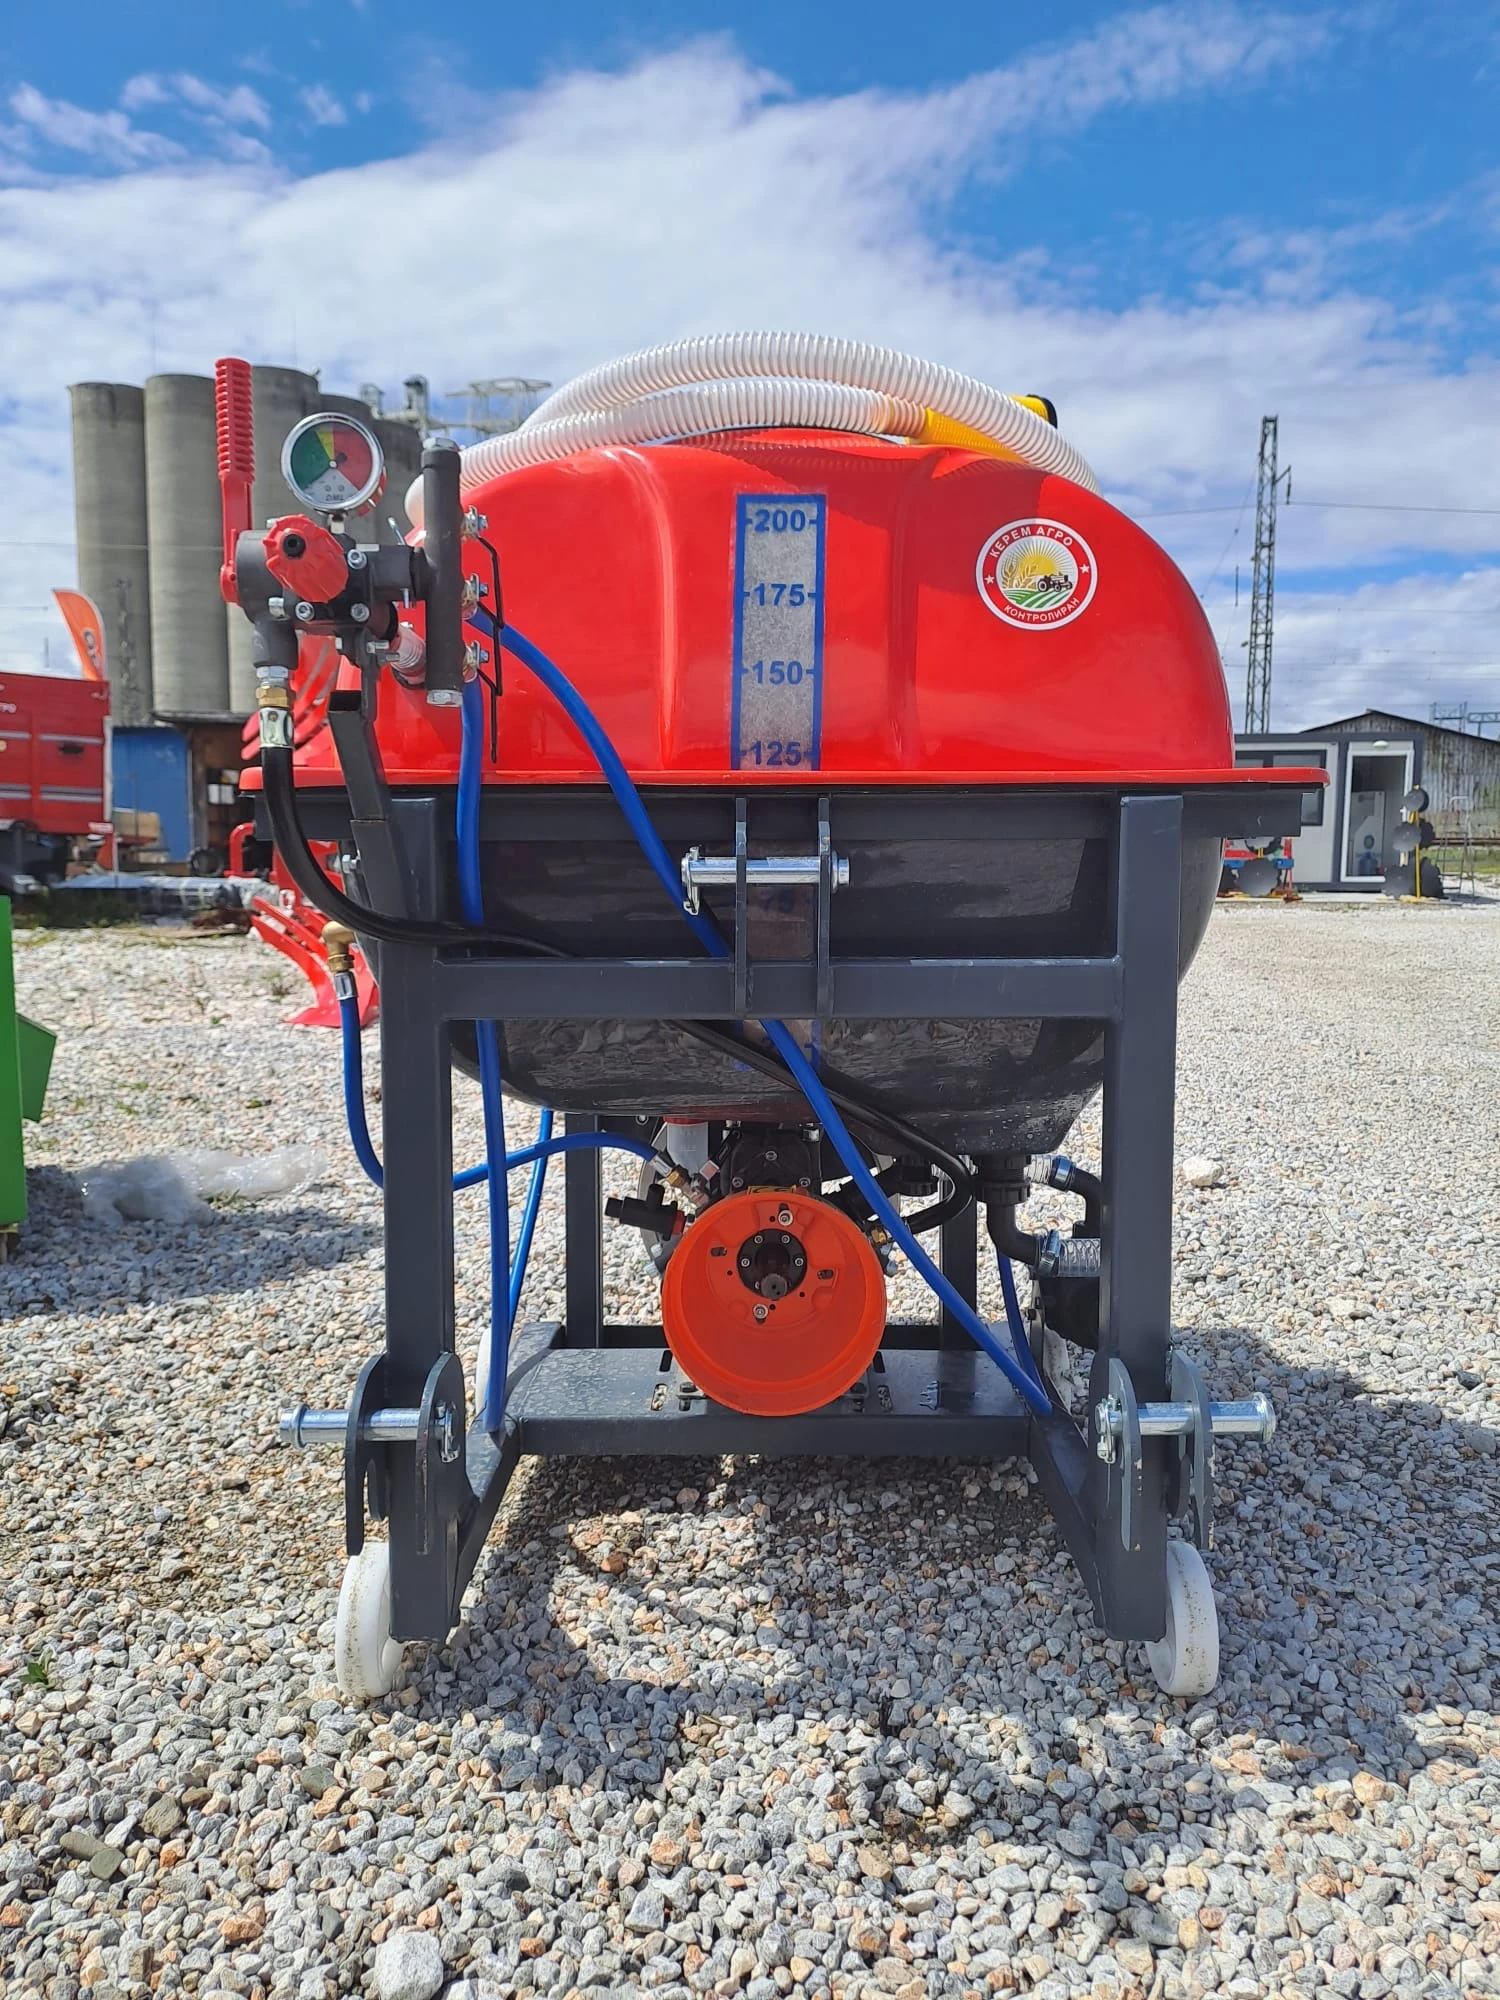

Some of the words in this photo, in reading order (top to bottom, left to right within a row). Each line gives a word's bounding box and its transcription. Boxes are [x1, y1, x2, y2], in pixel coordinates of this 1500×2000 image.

[754, 509, 806, 533] 200
[990, 527, 1031, 558] КЕРЕМ
[1036, 526, 1073, 546] АГРО
[754, 583, 805, 607] 175
[1004, 598, 1080, 622] КОНТРОЛИРАН
[752, 661, 803, 685] 150
[751, 741, 801, 767] 125
